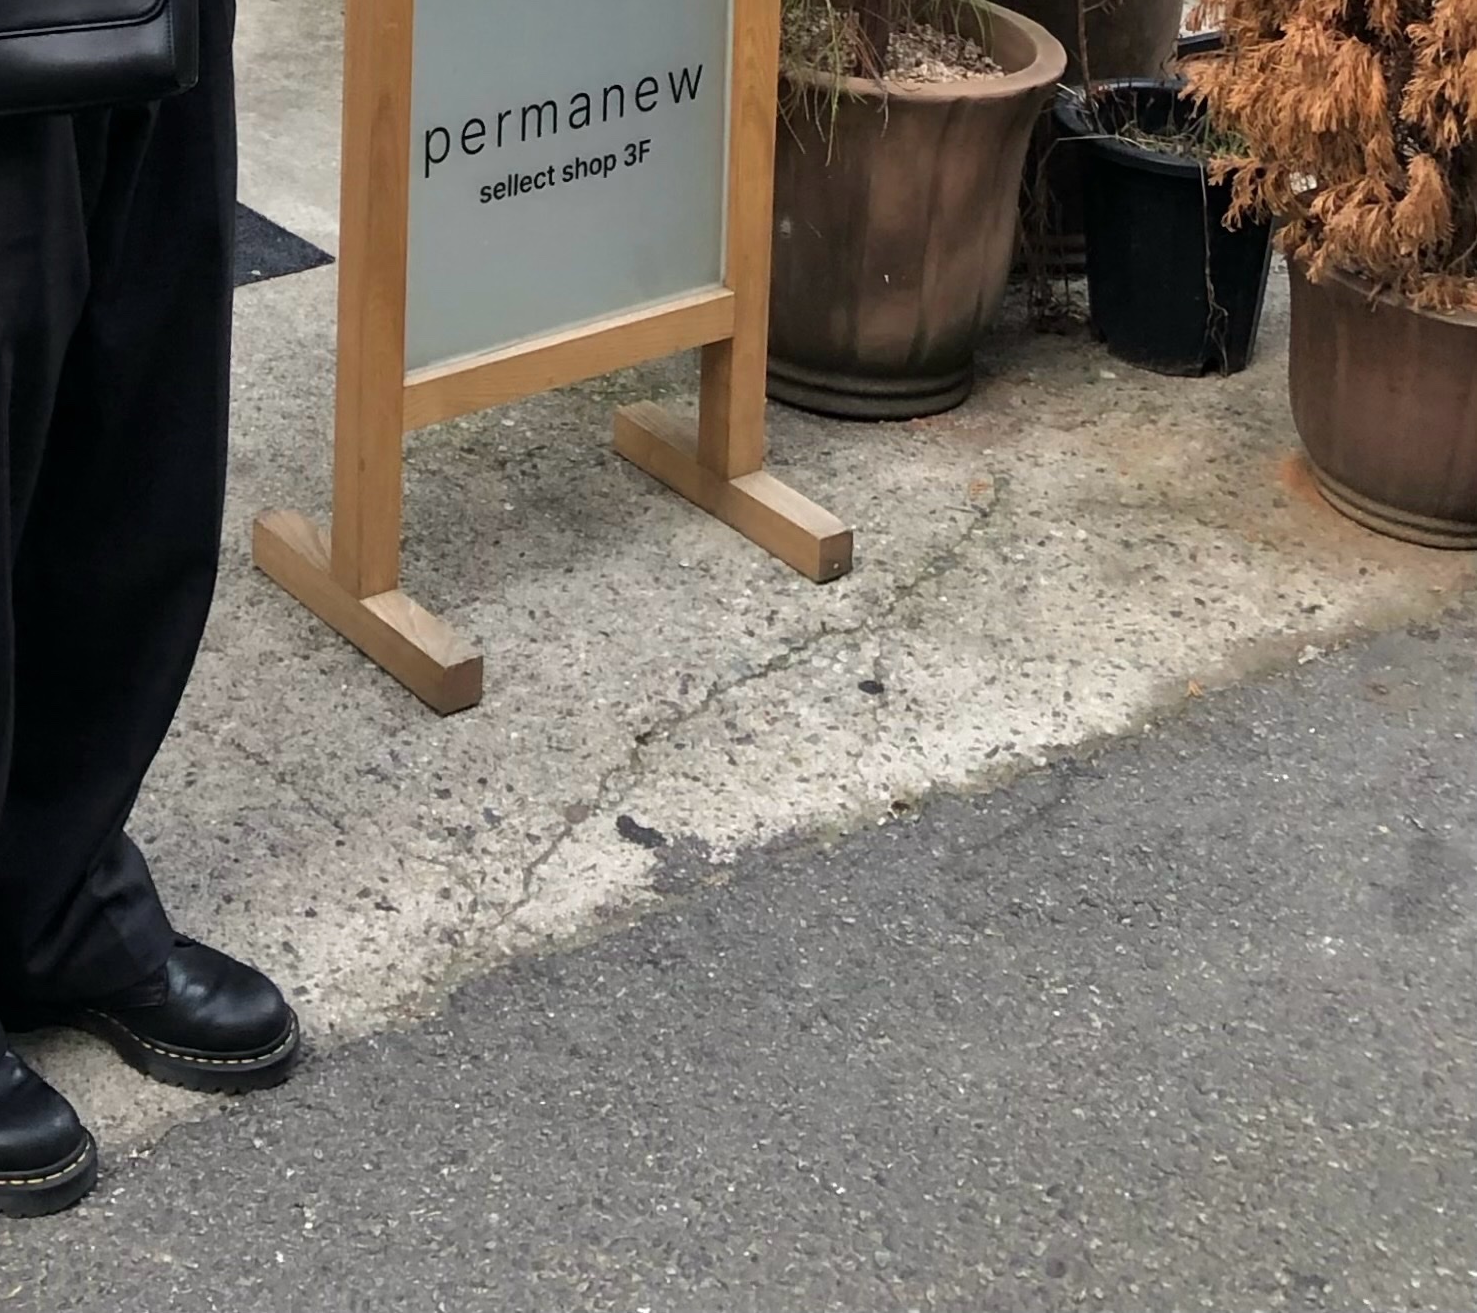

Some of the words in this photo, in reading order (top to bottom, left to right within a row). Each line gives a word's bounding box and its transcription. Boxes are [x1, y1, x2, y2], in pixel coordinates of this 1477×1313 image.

[423, 64, 703, 178] permanew
[479, 165, 556, 204] sellect
[562, 152, 618, 184] shop
[623, 139, 652, 167] 3F
